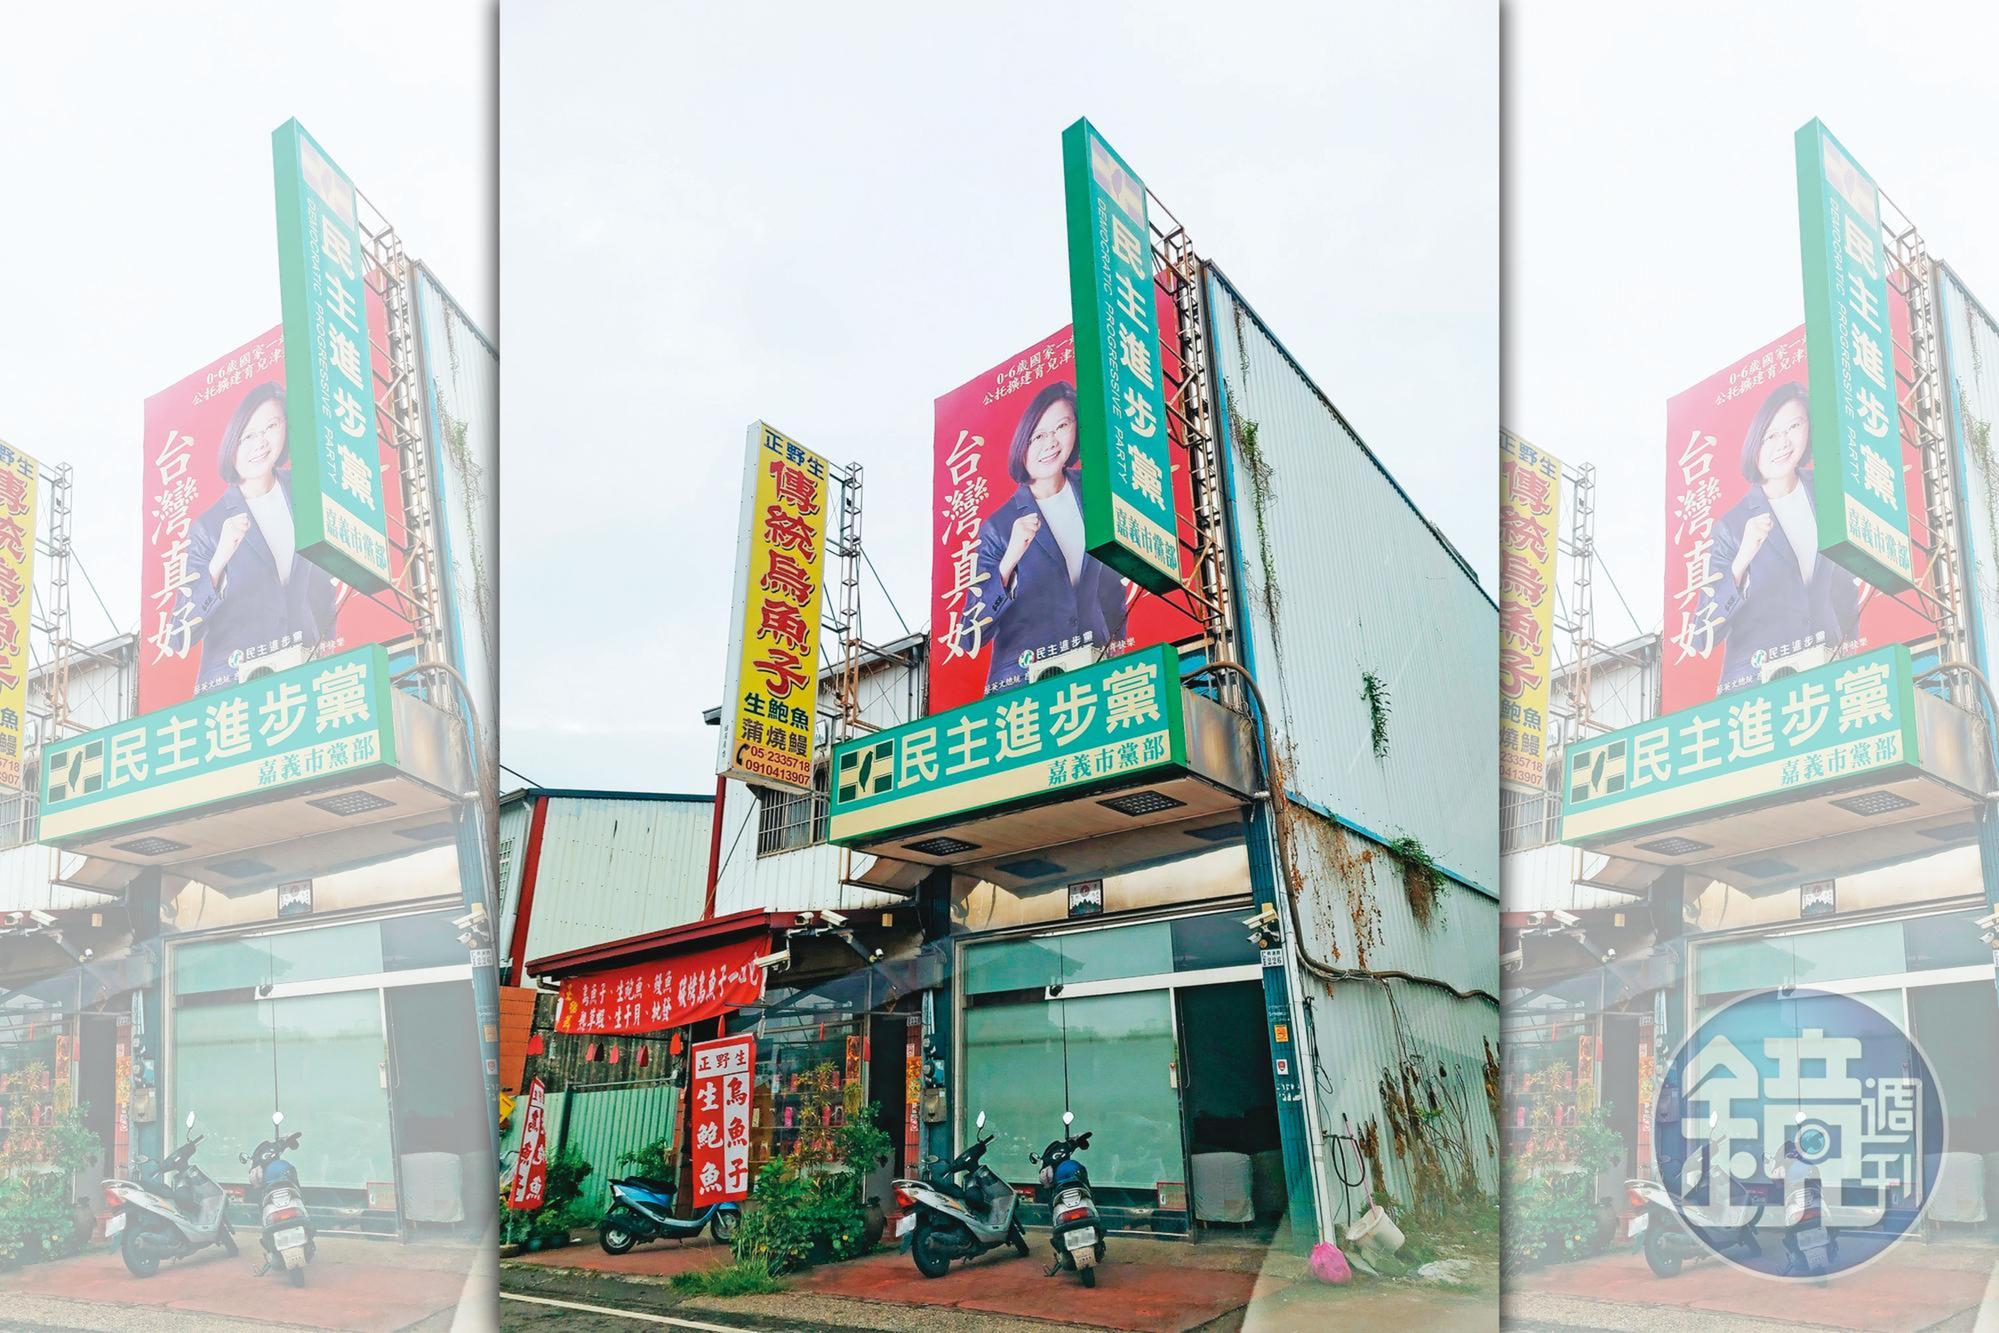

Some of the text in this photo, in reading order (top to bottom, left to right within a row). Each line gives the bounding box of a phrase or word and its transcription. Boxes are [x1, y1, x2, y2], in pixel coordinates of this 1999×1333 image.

[322, 218, 377, 511] 民主進步黨
[997, 334, 1074, 384] 0-6歲國家一
[1097, 197, 1129, 485] DEMOCRATIC PROGRESSIVE PARTY
[1112, 218, 1167, 511] 民主進步黨
[1844, 218, 1899, 511] 民主進步黨
[983, 348, 1075, 405] 公托擴建育兒津
[323, 425, 339, 485] PARTY
[764, 430, 825, 481] 正野生
[1845, 425, 1861, 485] PARTY
[147, 430, 203, 666] 台灣真好
[325, 506, 388, 570] 嘉義市黨部
[937, 430, 993, 666] 台灣真好
[1115, 506, 1178, 570] 嘉義市黨部
[1669, 430, 1725, 666] 台灣真好
[1847, 506, 1910, 570] 嘉義市黨部
[752, 459, 820, 699] 傳統烏魚子
[1036, 630, 1094, 660] 民主進步黨
[107, 662, 371, 789] 民主進步黨
[741, 717, 808, 758] 蒲燒鰻
[743, 692, 809, 732] 生鮑魚
[897, 662, 1161, 789] 民主進步黨
[1629, 662, 1893, 789] 民主進步黨
[257, 734, 375, 786] 嘉義市黨部
[745, 759, 810, 785] 0910413907
[1047, 734, 1165, 786] 嘉義市黨部
[1779, 734, 1897, 786] 嘉義市黨部
[698, 1049, 748, 1073] 正野生
[696, 1081, 724, 1195] 生鮑魚
[725, 1077, 748, 1190] 烏魚子
